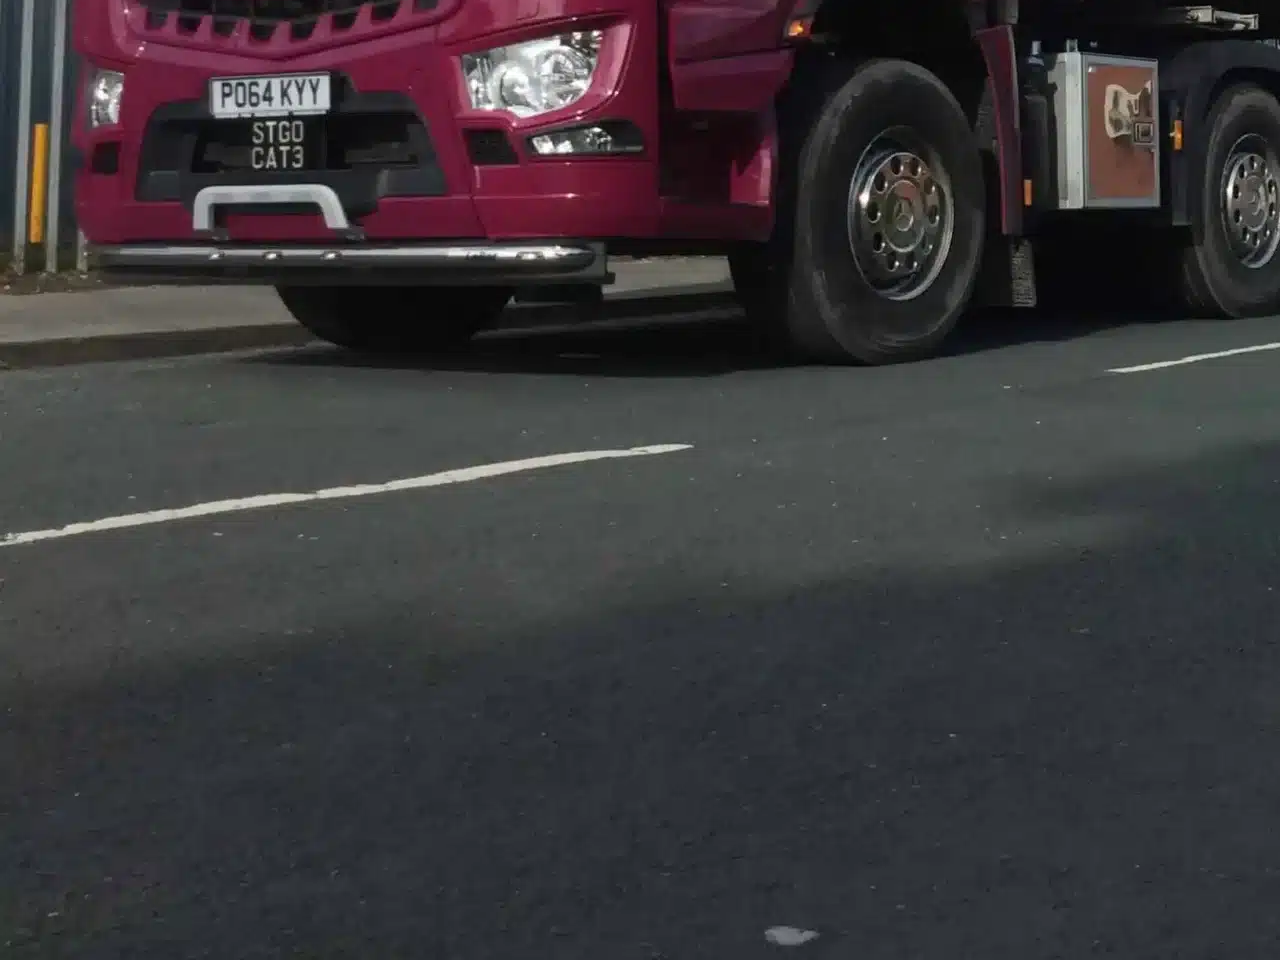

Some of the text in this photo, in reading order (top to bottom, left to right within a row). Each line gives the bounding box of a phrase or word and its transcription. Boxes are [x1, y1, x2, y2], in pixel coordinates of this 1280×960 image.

[281, 77, 321, 106] KYY
[252, 120, 304, 144] STGO
[252, 145, 304, 169] CAT3
